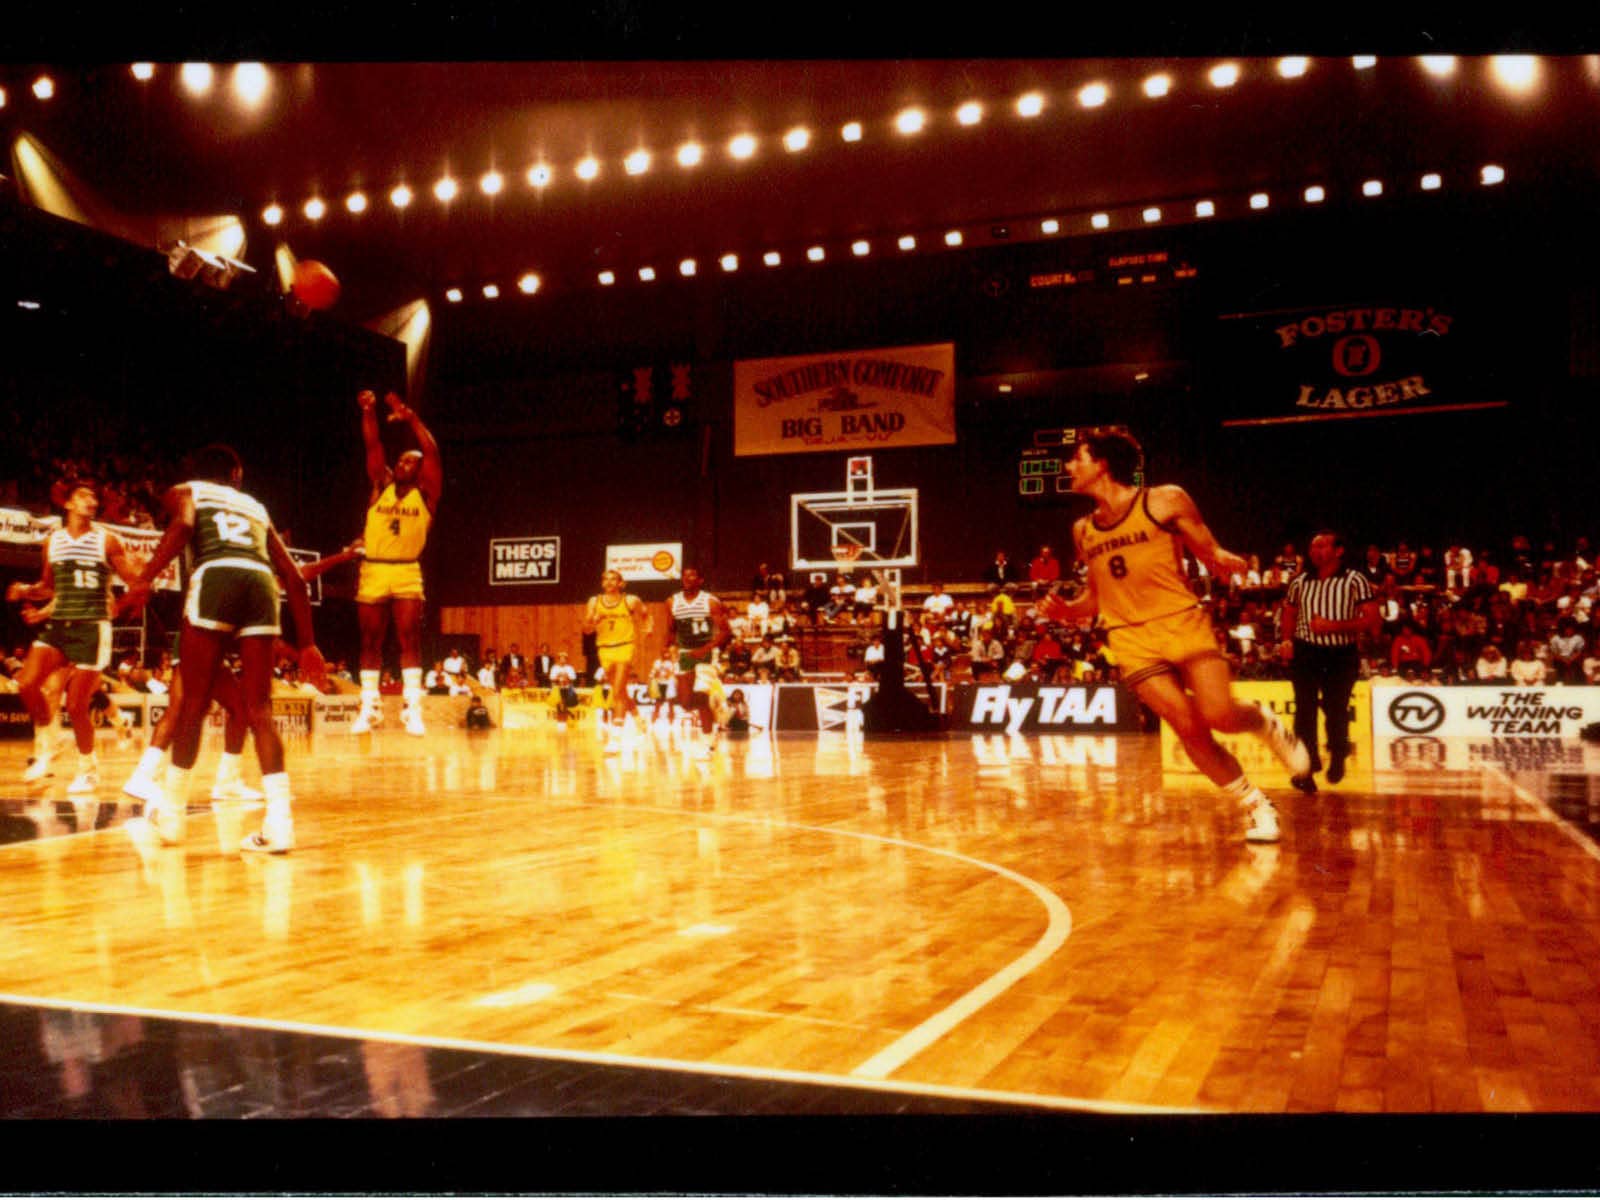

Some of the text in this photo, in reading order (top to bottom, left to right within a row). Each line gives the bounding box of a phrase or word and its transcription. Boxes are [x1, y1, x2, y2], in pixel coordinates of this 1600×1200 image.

[1275, 307, 1453, 349] FOSTER'S
[753, 359, 945, 408] SOUTHERN COMFORT
[1296, 375, 1431, 409] LAGER
[781, 417, 824, 440] BIG
[840, 411, 906, 435] BAND
[212, 511, 253, 545] 12
[388, 517, 401, 536] 4
[494, 543, 556, 561] THEOS
[496, 561, 552, 579] MEAT
[1109, 554, 1128, 580] 8
[73, 569, 100, 589] 15
[971, 686, 1117, 734] Fly TAA
[1500, 692, 1546, 706] THE
[1466, 706, 1584, 720] WINNING
[1490, 720, 1562, 735] TEAM
